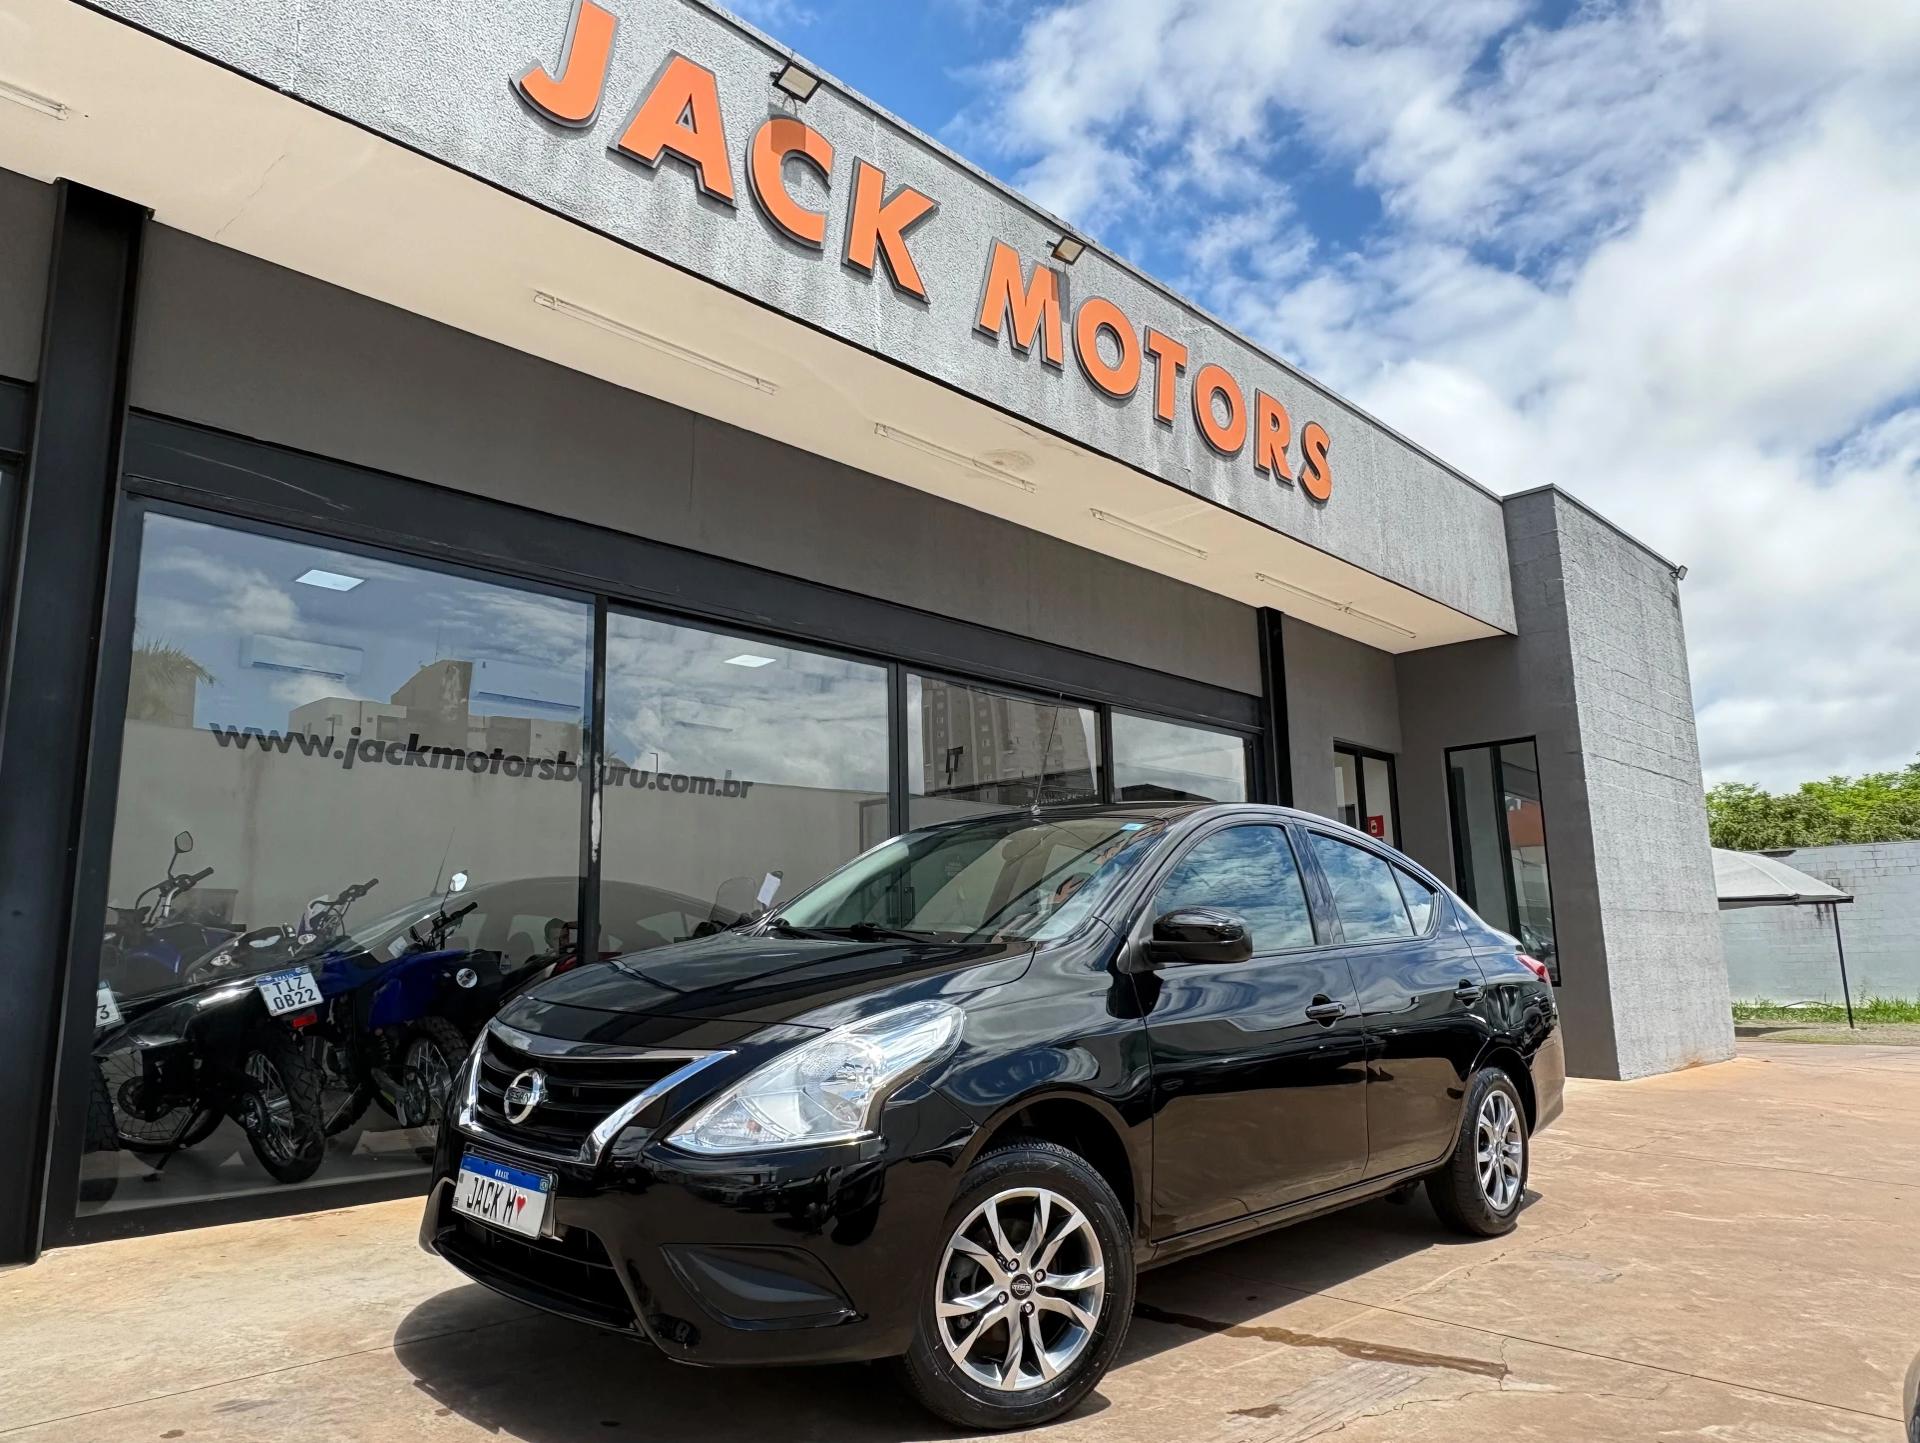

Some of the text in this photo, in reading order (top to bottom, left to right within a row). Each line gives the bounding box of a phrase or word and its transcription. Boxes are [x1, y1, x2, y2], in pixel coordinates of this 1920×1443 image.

[512, 0, 1332, 501] JACK MOTORS
[209, 722, 754, 799] www.jackmotorsburu.com.br
[272, 976, 306, 995] TIZ
[466, 1176, 504, 1219] JACK
